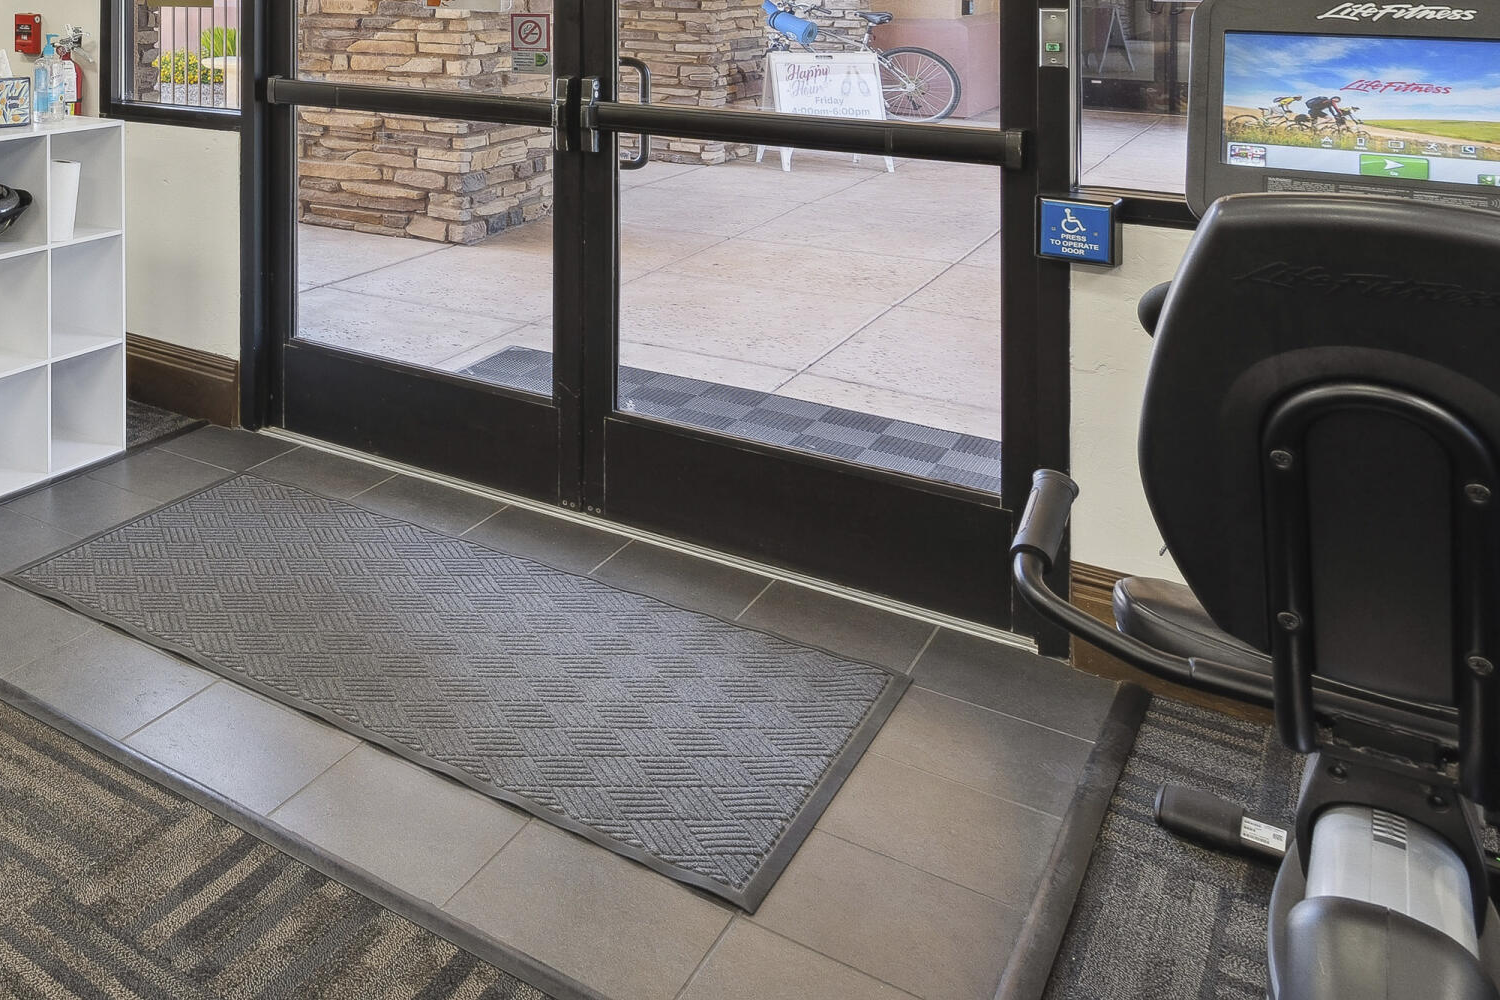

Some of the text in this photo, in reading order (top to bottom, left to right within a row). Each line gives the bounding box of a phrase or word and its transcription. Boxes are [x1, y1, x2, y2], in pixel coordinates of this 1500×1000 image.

[786, 63, 831, 82] Happy
[815, 96, 844, 105] Friday
[1060, 233, 1087, 242] PRESS
[1049, 238, 1100, 251] TO OPERATE
[1061, 247, 1085, 256] DOOR
